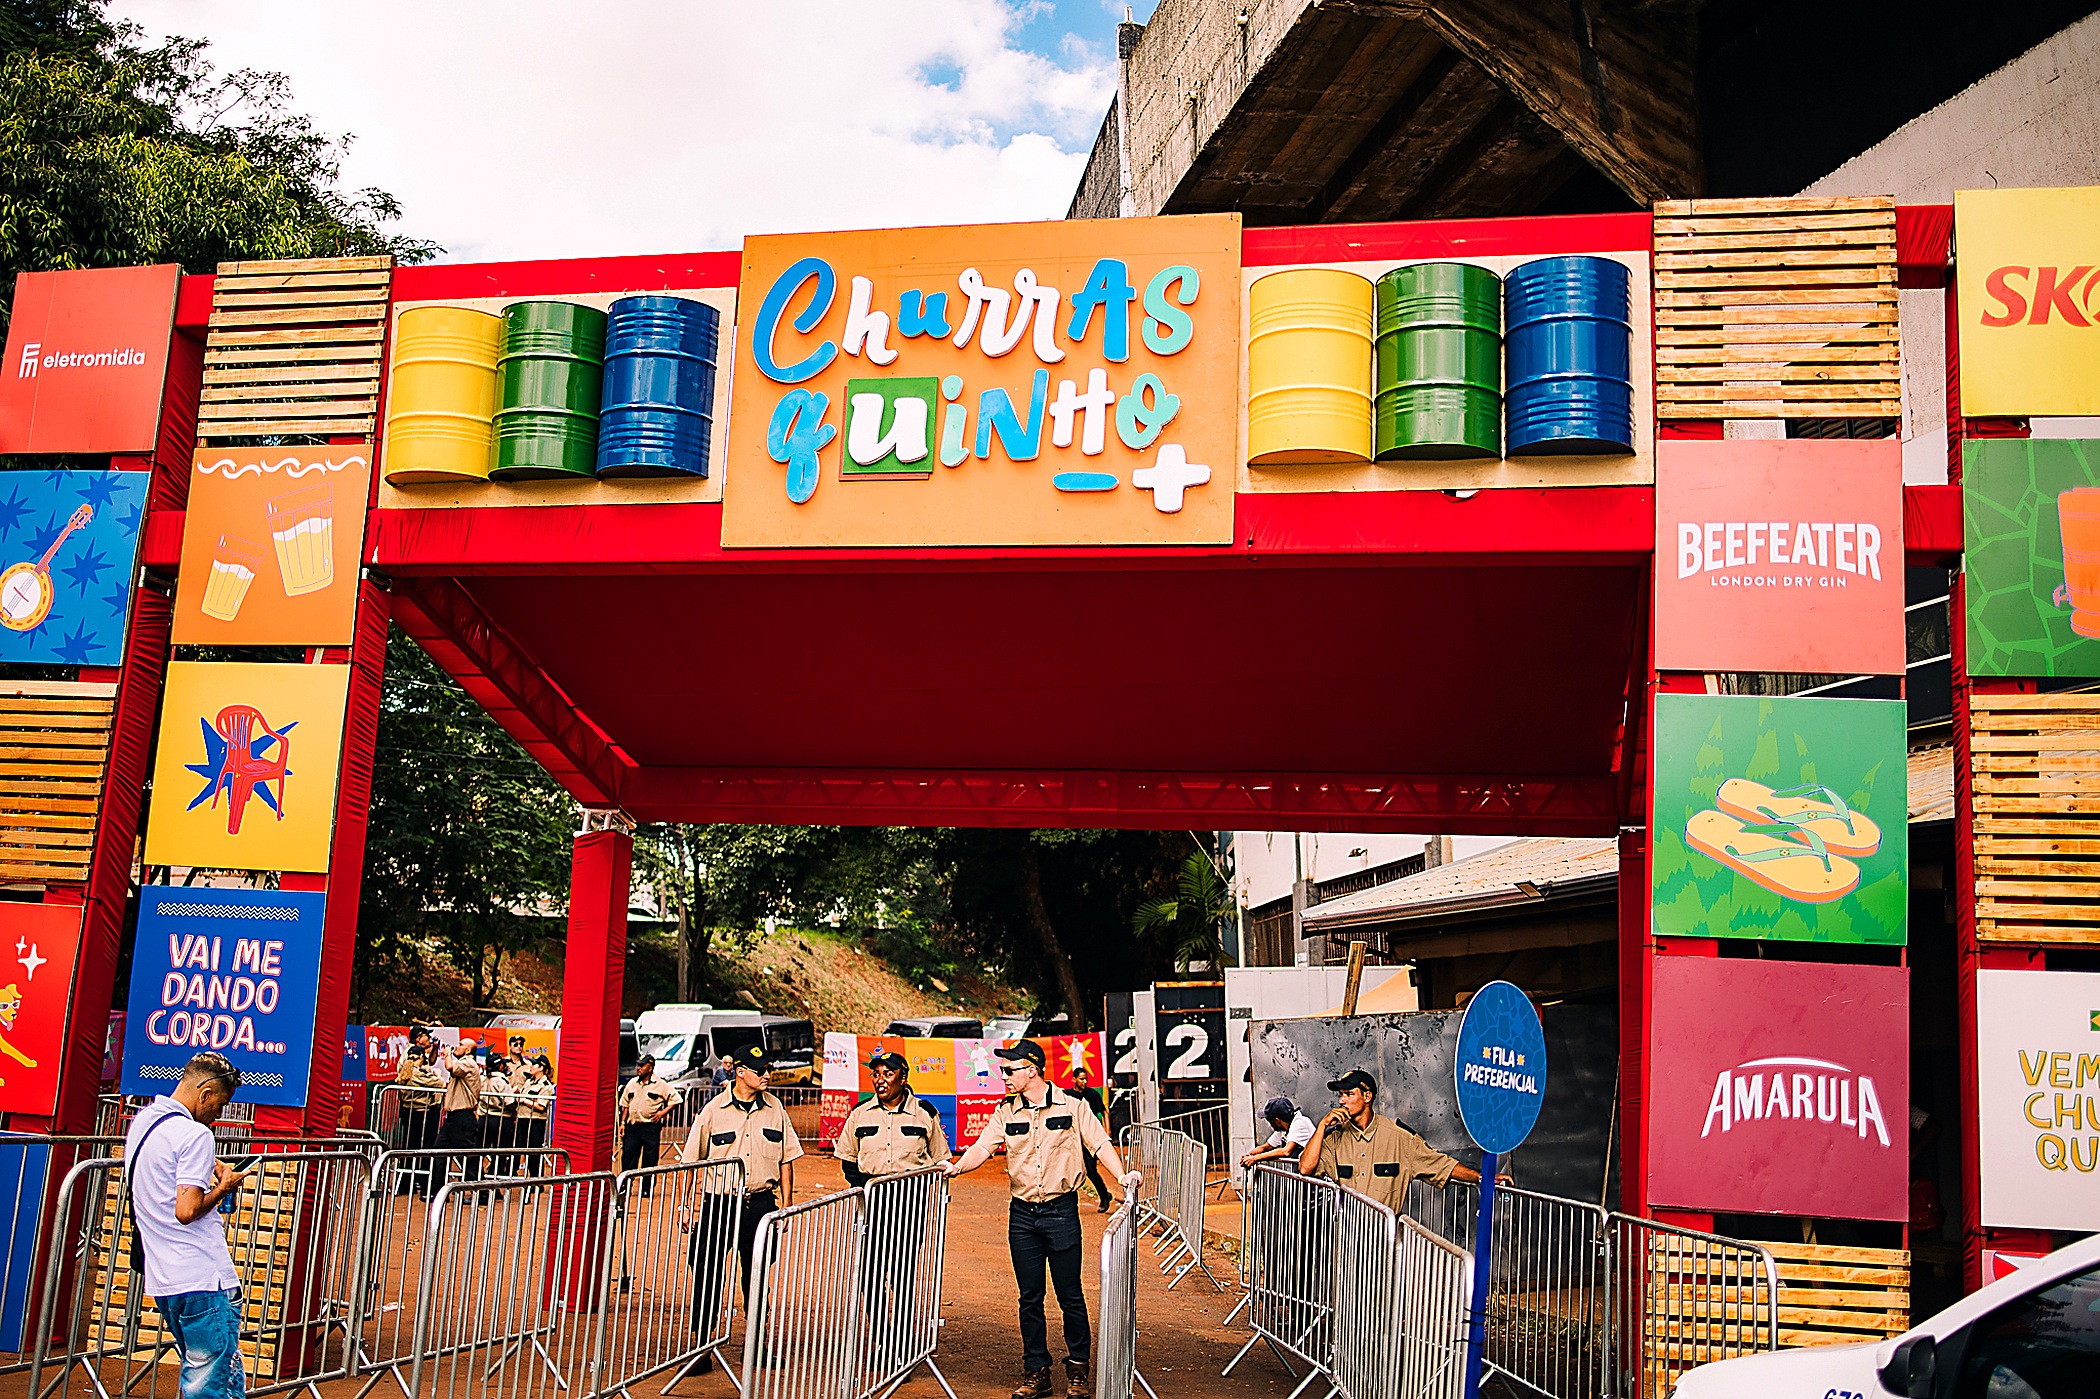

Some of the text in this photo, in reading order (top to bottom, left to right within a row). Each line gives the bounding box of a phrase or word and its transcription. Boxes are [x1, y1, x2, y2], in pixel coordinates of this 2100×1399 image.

[43, 348, 146, 368] eletromidia
[1677, 521, 1882, 581] BEEFEATER
[1711, 575, 1847, 588] LONDON DRY GIN
[169, 934, 284, 976] VAI ME
[161, 971, 280, 1014] DANDO
[145, 1009, 286, 1054] CORDA...
[1165, 1024, 1210, 1078] 2
[1492, 1046, 1516, 1068] FILA
[1463, 1062, 1539, 1095] PREFERENCIAL
[1700, 1070, 1891, 1147] AMARULA
